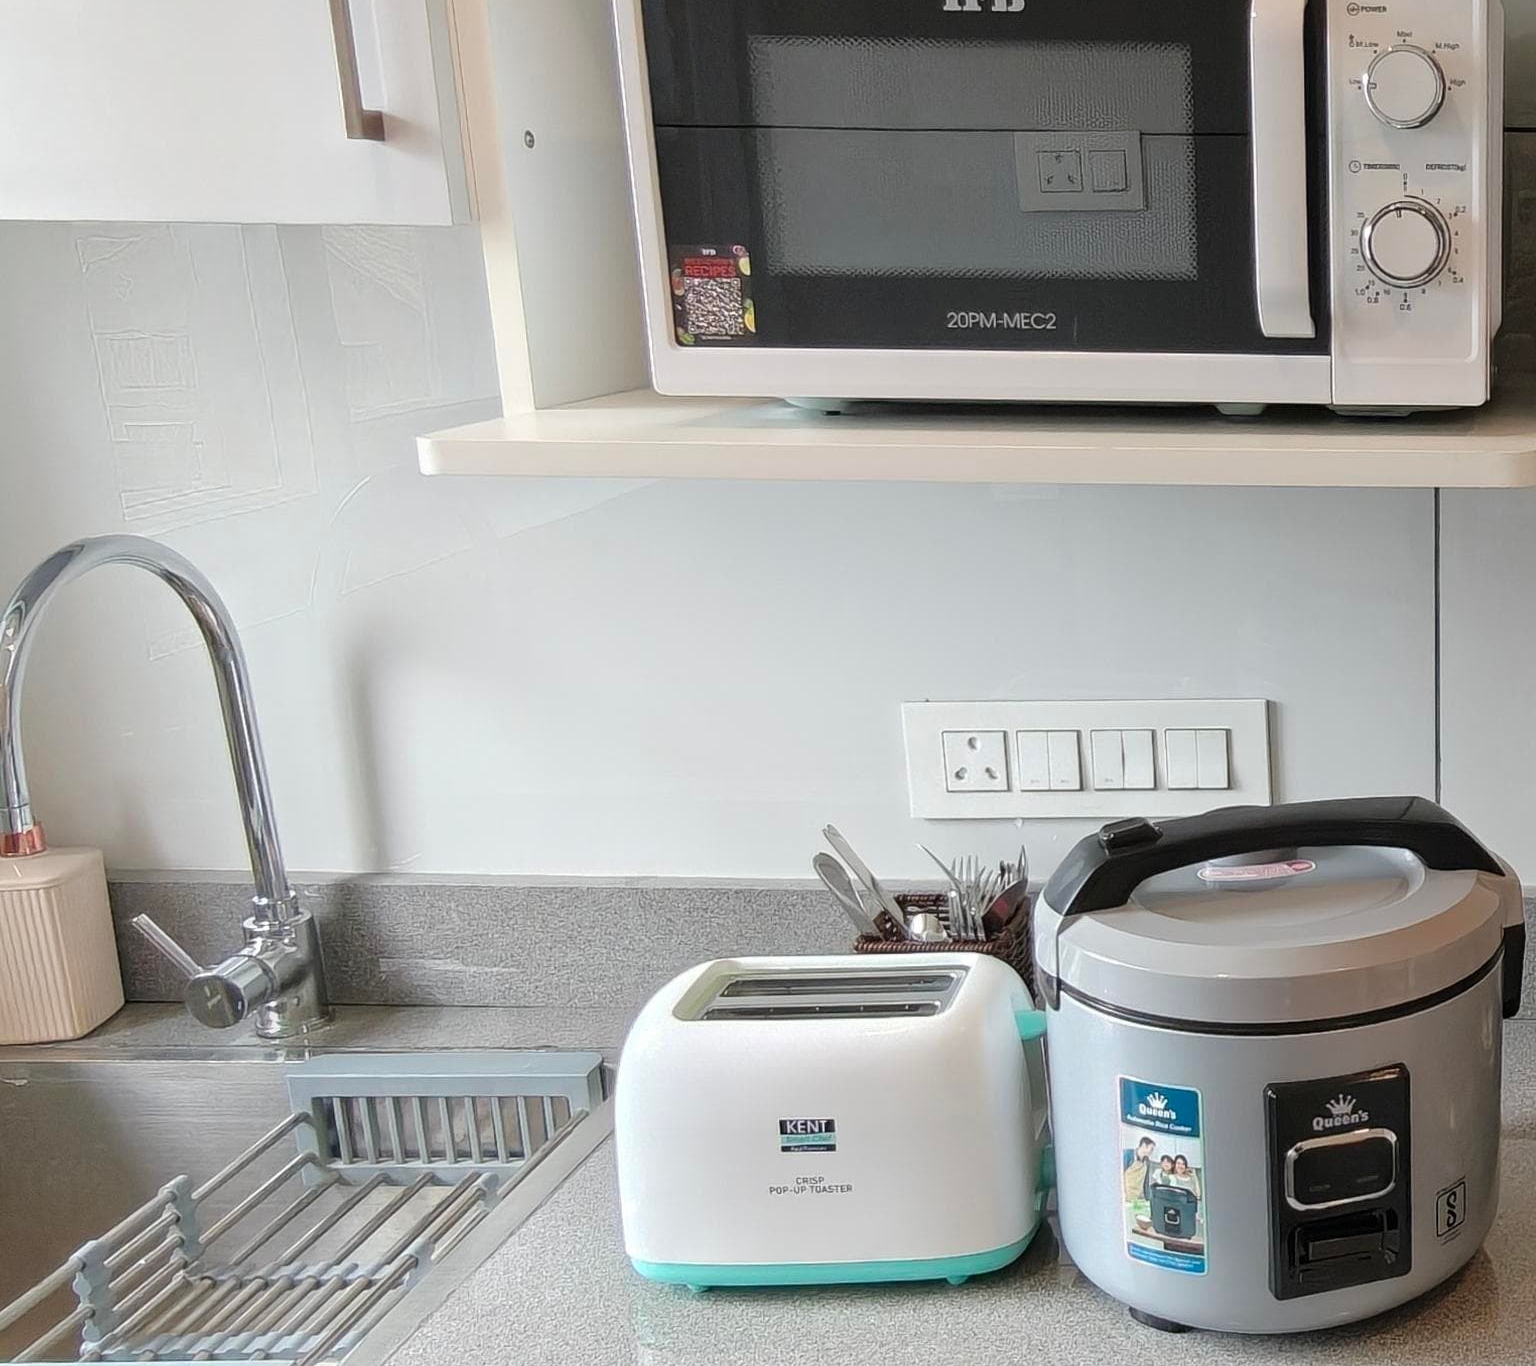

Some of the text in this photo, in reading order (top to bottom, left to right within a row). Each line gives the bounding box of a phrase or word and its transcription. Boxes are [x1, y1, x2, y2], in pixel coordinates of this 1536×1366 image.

[685, 265, 737, 276] RECIPES
[946, 312, 1057, 329] 20PM-MEC2
[1139, 1102, 1177, 1120] Queen's
[786, 1120, 828, 1134] KENT
[1312, 1110, 1369, 1131] Queen's
[796, 1176, 825, 1186] CRISP
[769, 1184, 853, 1195] POP-UP TOASTER
